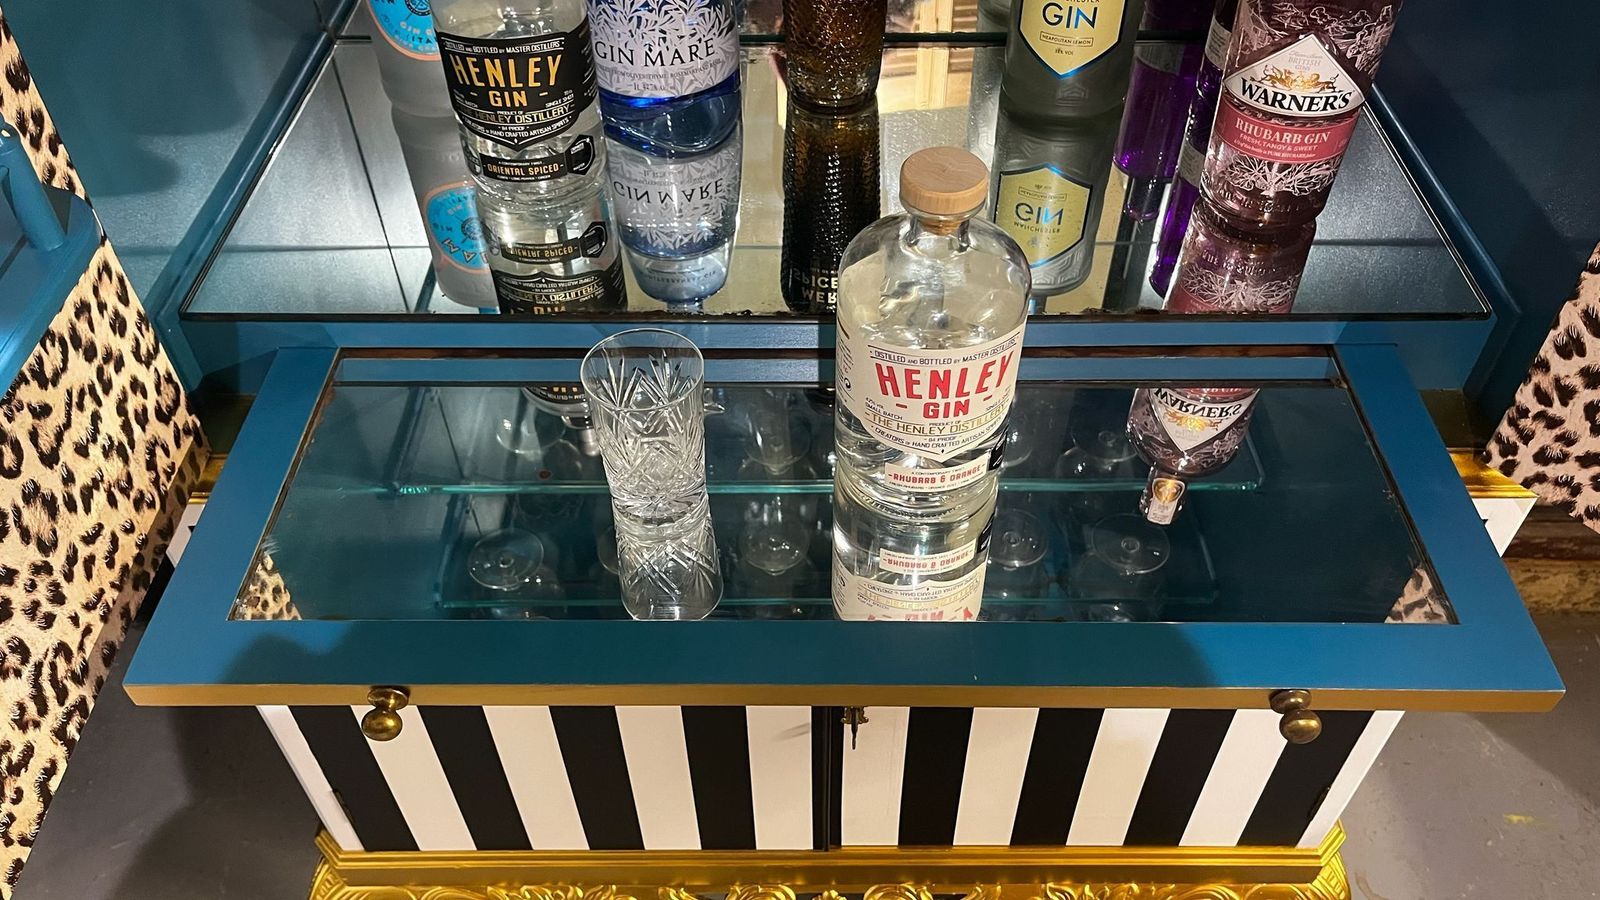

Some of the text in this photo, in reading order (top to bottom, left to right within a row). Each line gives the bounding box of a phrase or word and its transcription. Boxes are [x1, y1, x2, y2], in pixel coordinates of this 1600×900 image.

[1042, 2, 1098, 29] GIN
[473, 46, 498, 54] BOTTLED
[506, 45, 530, 53] MASTER
[531, 40, 560, 52] DISTILLERS
[594, 38, 715, 67] GIN MARE
[450, 54, 561, 87] HENLEY
[488, 90, 528, 107] GIN
[1240, 77, 1352, 112] WARNER'S
[515, 104, 569, 124] DISTILLERY
[490, 129, 504, 137] HAND
[529, 125, 551, 136] ARTISAN
[1235, 118, 1301, 144] RHUBARB
[1304, 131, 1331, 144] GIN
[1262, 141, 1286, 151] TANGY
[487, 163, 525, 176] ORIENTAL
[528, 163, 559, 175] SPICED
[875, 350, 906, 363] DISTILLED
[962, 351, 990, 362] MASTER
[990, 339, 1016, 356] DISTILLERS
[875, 351, 1014, 400] HENLEY
[872, 403, 1006, 435] THE HENLEY DISTILLERY
[883, 411, 903, 420] BATCH
[923, 399, 970, 419] GIN
[875, 427, 905, 444] CREATORS
[931, 440, 960, 448] CRAFTED
[961, 431, 985, 444] ARTISAN
[893, 473, 936, 484] RHUBARB
[950, 465, 981, 482] ORANGE
